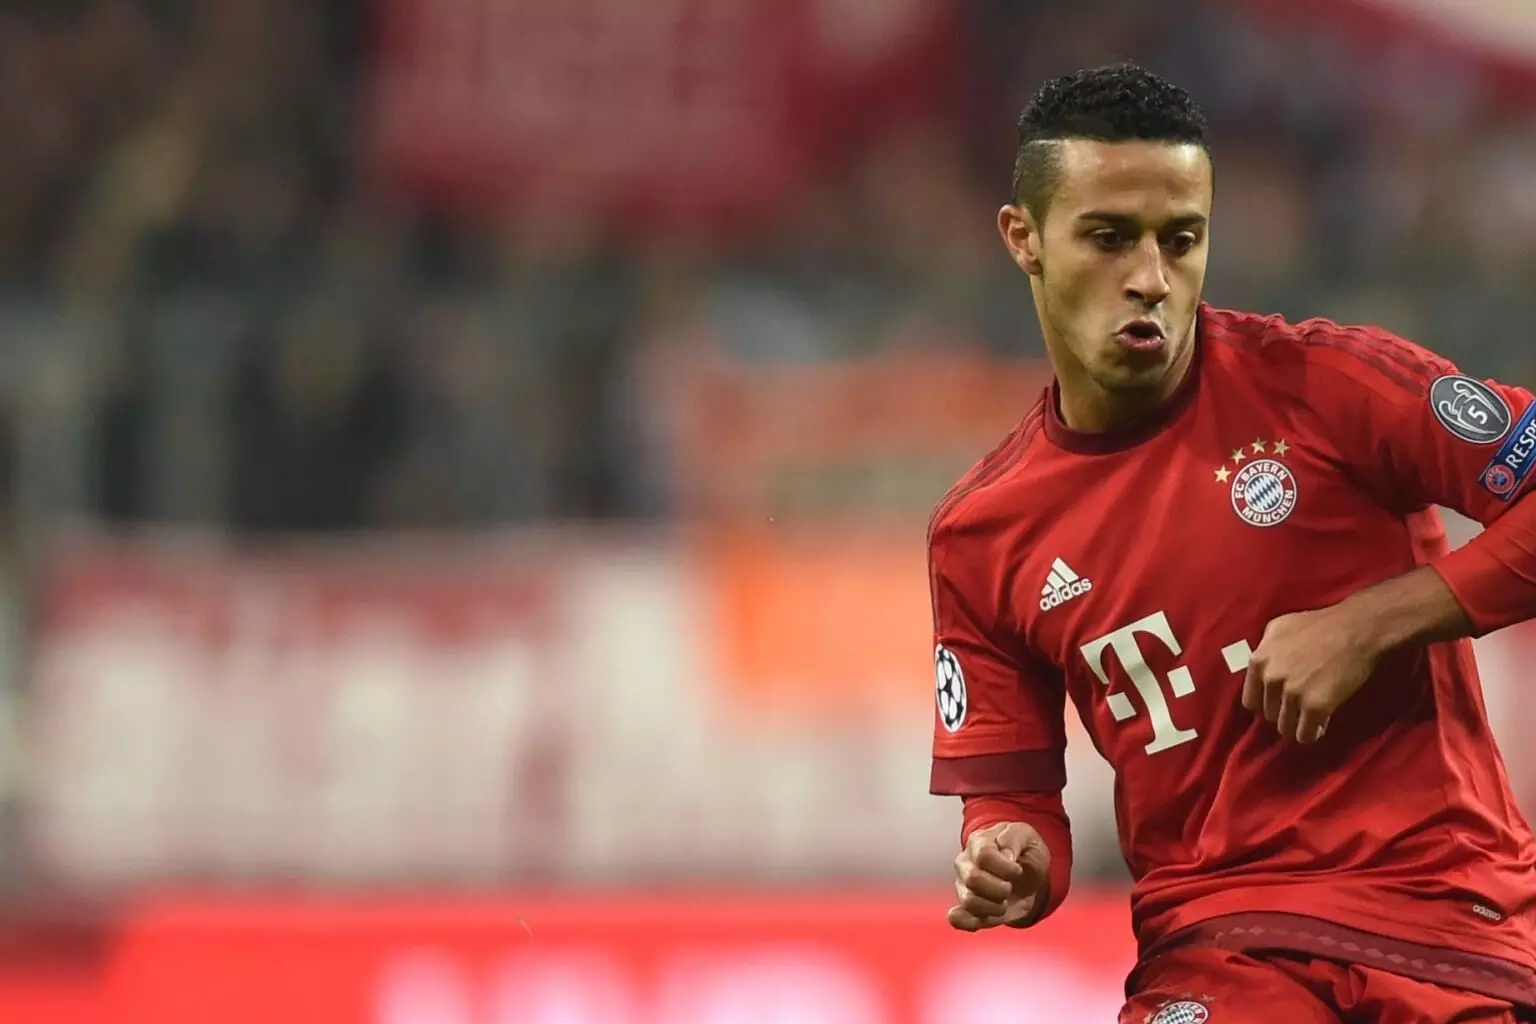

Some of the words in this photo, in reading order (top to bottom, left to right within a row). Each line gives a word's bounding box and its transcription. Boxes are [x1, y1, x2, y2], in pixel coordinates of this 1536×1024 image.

[1467, 405, 1488, 425] 5
[1234, 483, 1245, 499] FC
[1240, 462, 1288, 482] BAYERN
[1039, 577, 1093, 612] adidas
[1080, 610, 1199, 756] T
